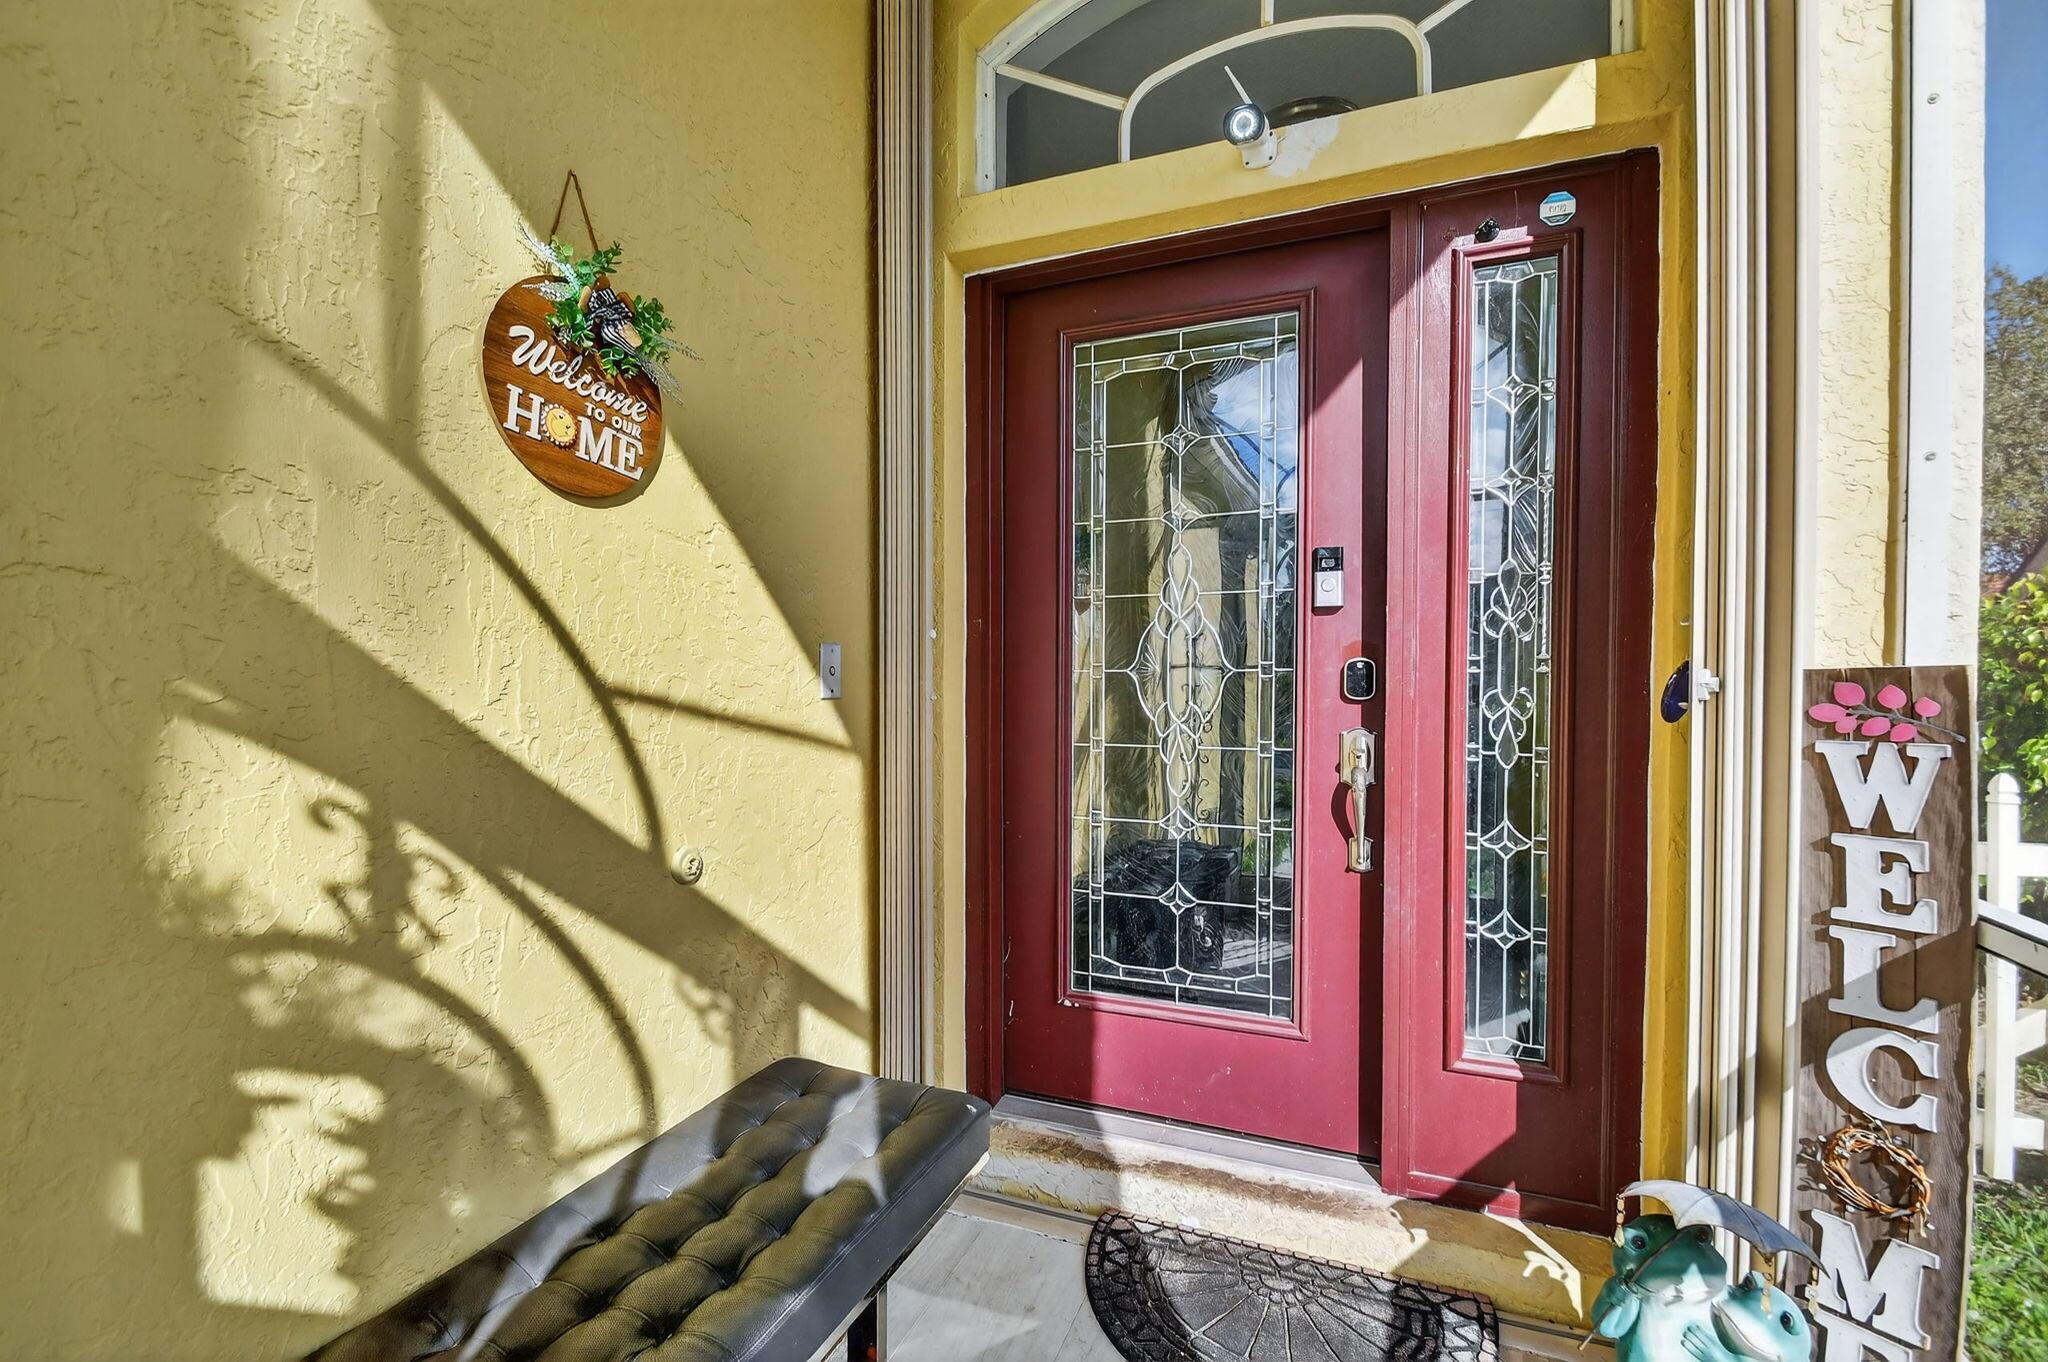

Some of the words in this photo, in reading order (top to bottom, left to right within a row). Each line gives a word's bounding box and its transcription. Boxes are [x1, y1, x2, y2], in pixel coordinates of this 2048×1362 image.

[509, 325, 648, 422] Welcome
[584, 402, 606, 422] TO
[611, 415, 642, 439] OUR
